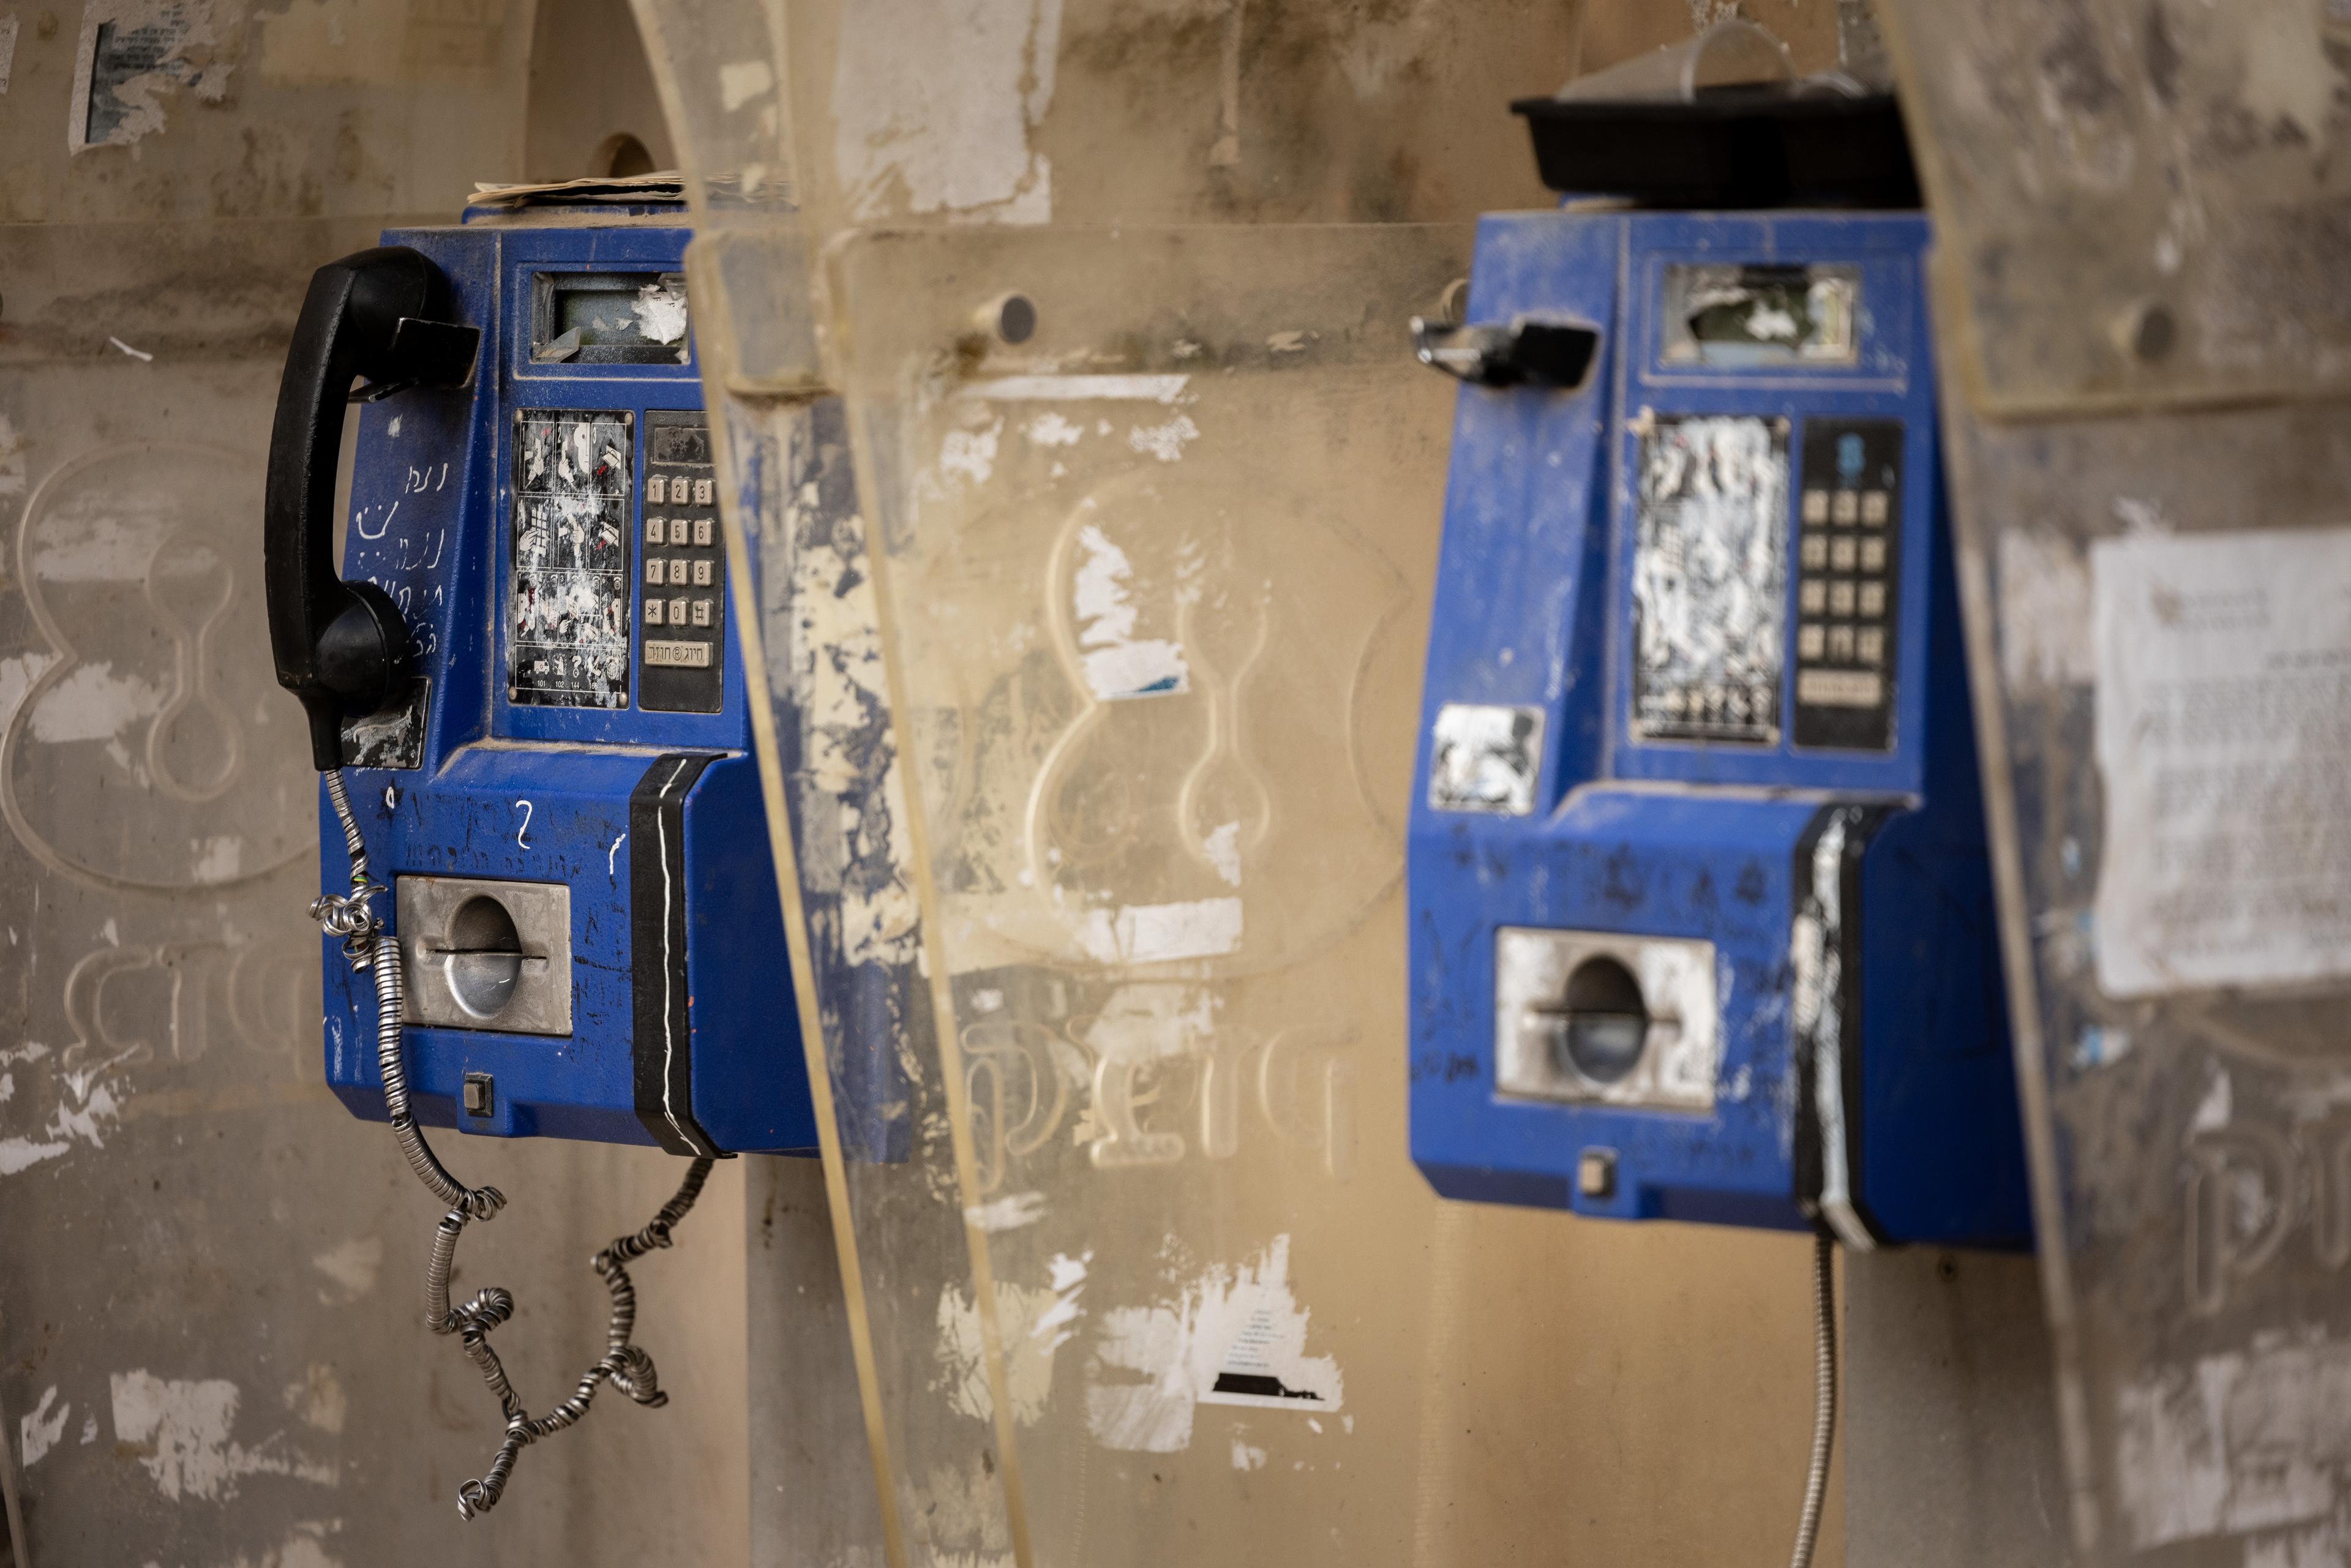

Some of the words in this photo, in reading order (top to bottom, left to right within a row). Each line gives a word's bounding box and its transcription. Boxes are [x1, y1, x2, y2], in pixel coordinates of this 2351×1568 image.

[557, 426, 561, 443] 2
[592, 427, 597, 444] 3
[652, 485, 658, 498] 1
[675, 485, 681, 499] 2
[699, 486, 705, 500] 3
[650, 525, 656, 538] 4
[675, 525, 680, 539] 5
[698, 526, 703, 539] 6
[650, 565, 656, 579] 7
[674, 566, 680, 580] 8
[698, 566, 703, 580] 9
[673, 606, 679, 620] 0
[648, 646, 671, 661] חוזר
[684, 647, 703, 661] חיוג
